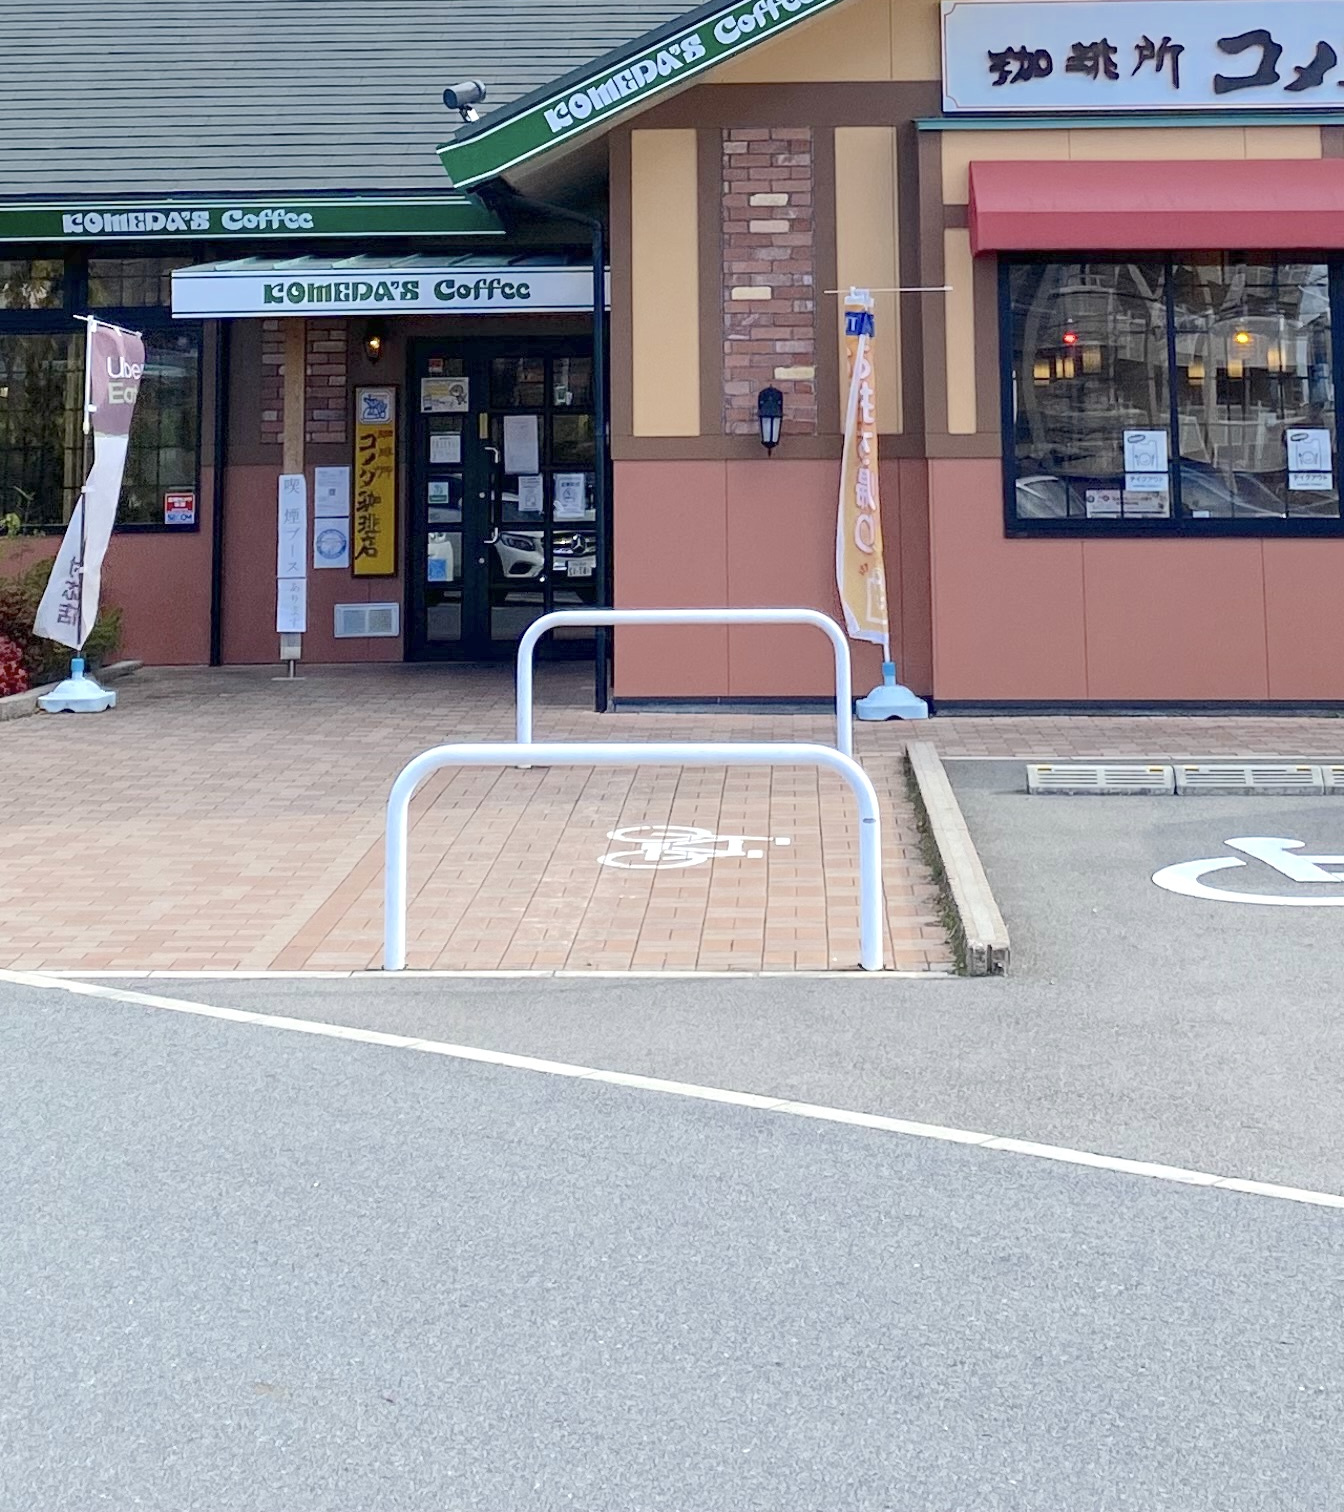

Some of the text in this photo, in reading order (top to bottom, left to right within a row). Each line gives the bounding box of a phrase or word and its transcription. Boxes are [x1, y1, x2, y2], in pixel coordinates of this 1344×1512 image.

[543, 32, 707, 133] KOMEDA'S
[62, 208, 314, 234] KOMEDA'S Coffee
[263, 278, 531, 304] KOMEDA'S Coffee
[283, 478, 301, 572] 喫煙ブース
